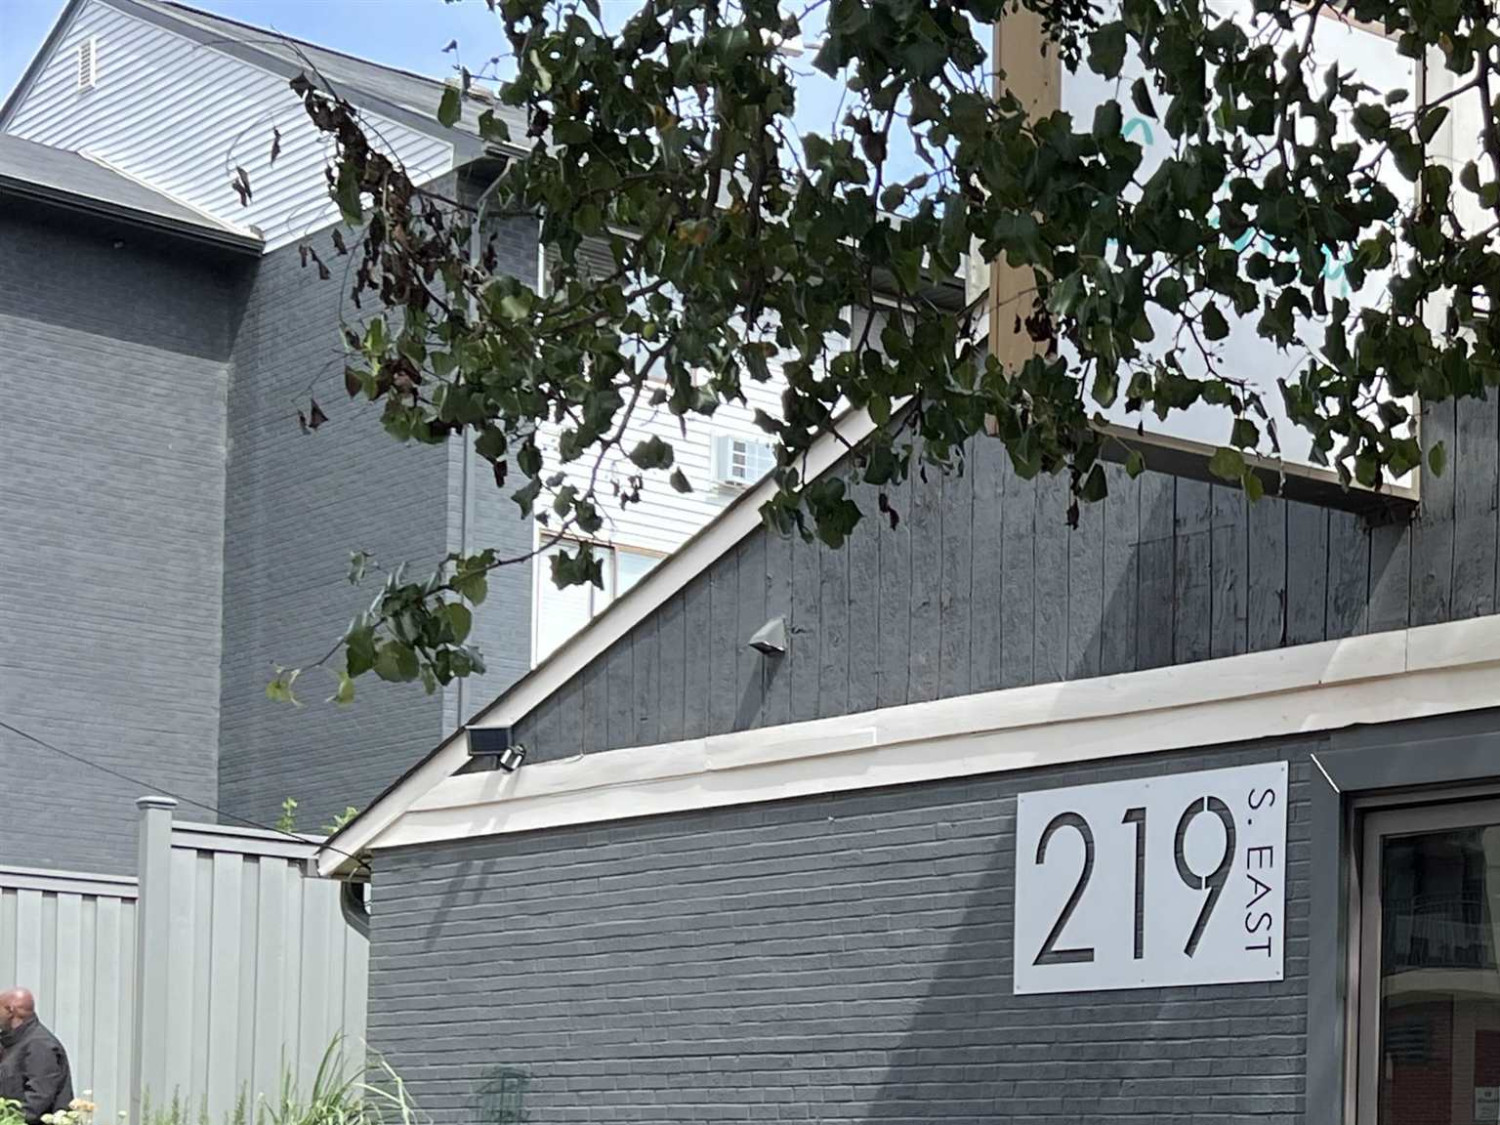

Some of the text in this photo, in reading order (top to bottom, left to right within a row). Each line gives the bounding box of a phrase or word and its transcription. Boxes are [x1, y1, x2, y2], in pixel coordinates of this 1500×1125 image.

[1032, 795, 1237, 966] 219
[1245, 788, 1276, 958] S. EAST
